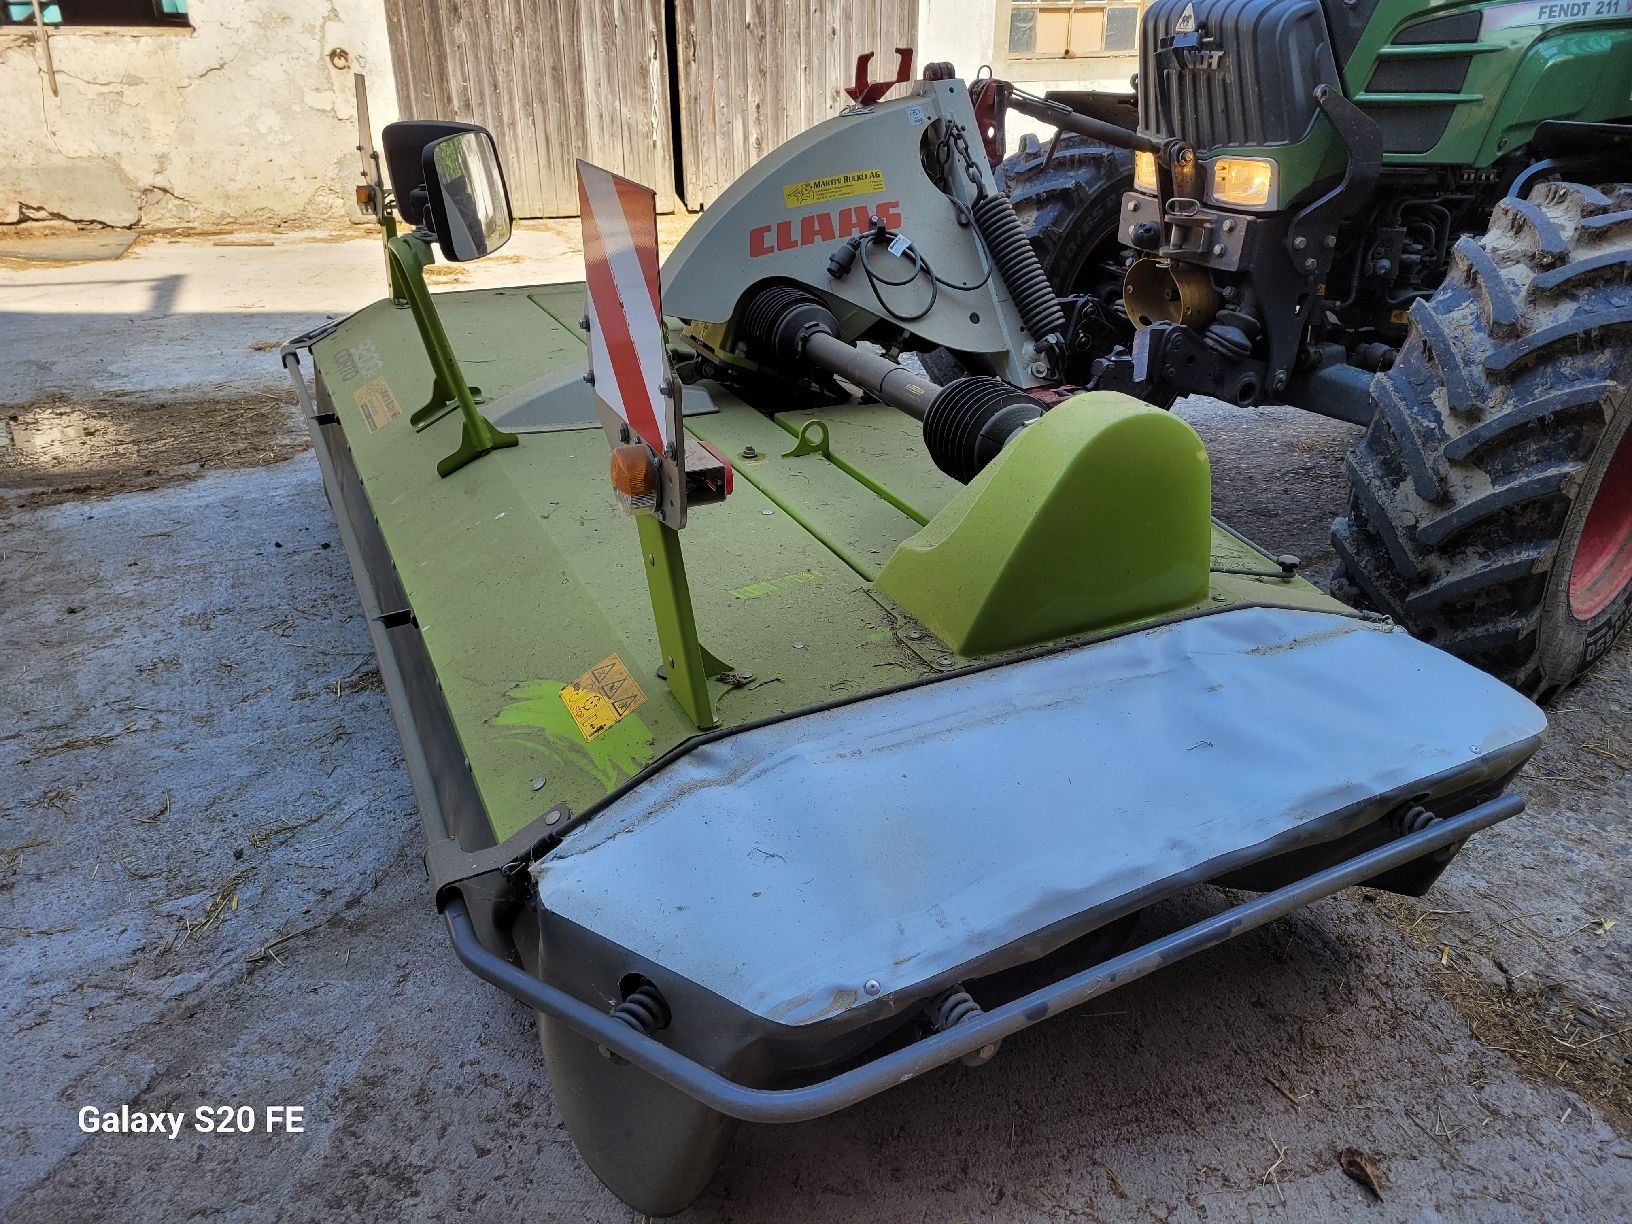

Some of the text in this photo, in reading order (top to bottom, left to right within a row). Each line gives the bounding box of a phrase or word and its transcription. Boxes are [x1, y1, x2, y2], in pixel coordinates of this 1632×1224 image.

[1538, 0, 1619, 19] FENDT 211
[750, 201, 902, 258] CLAAS
